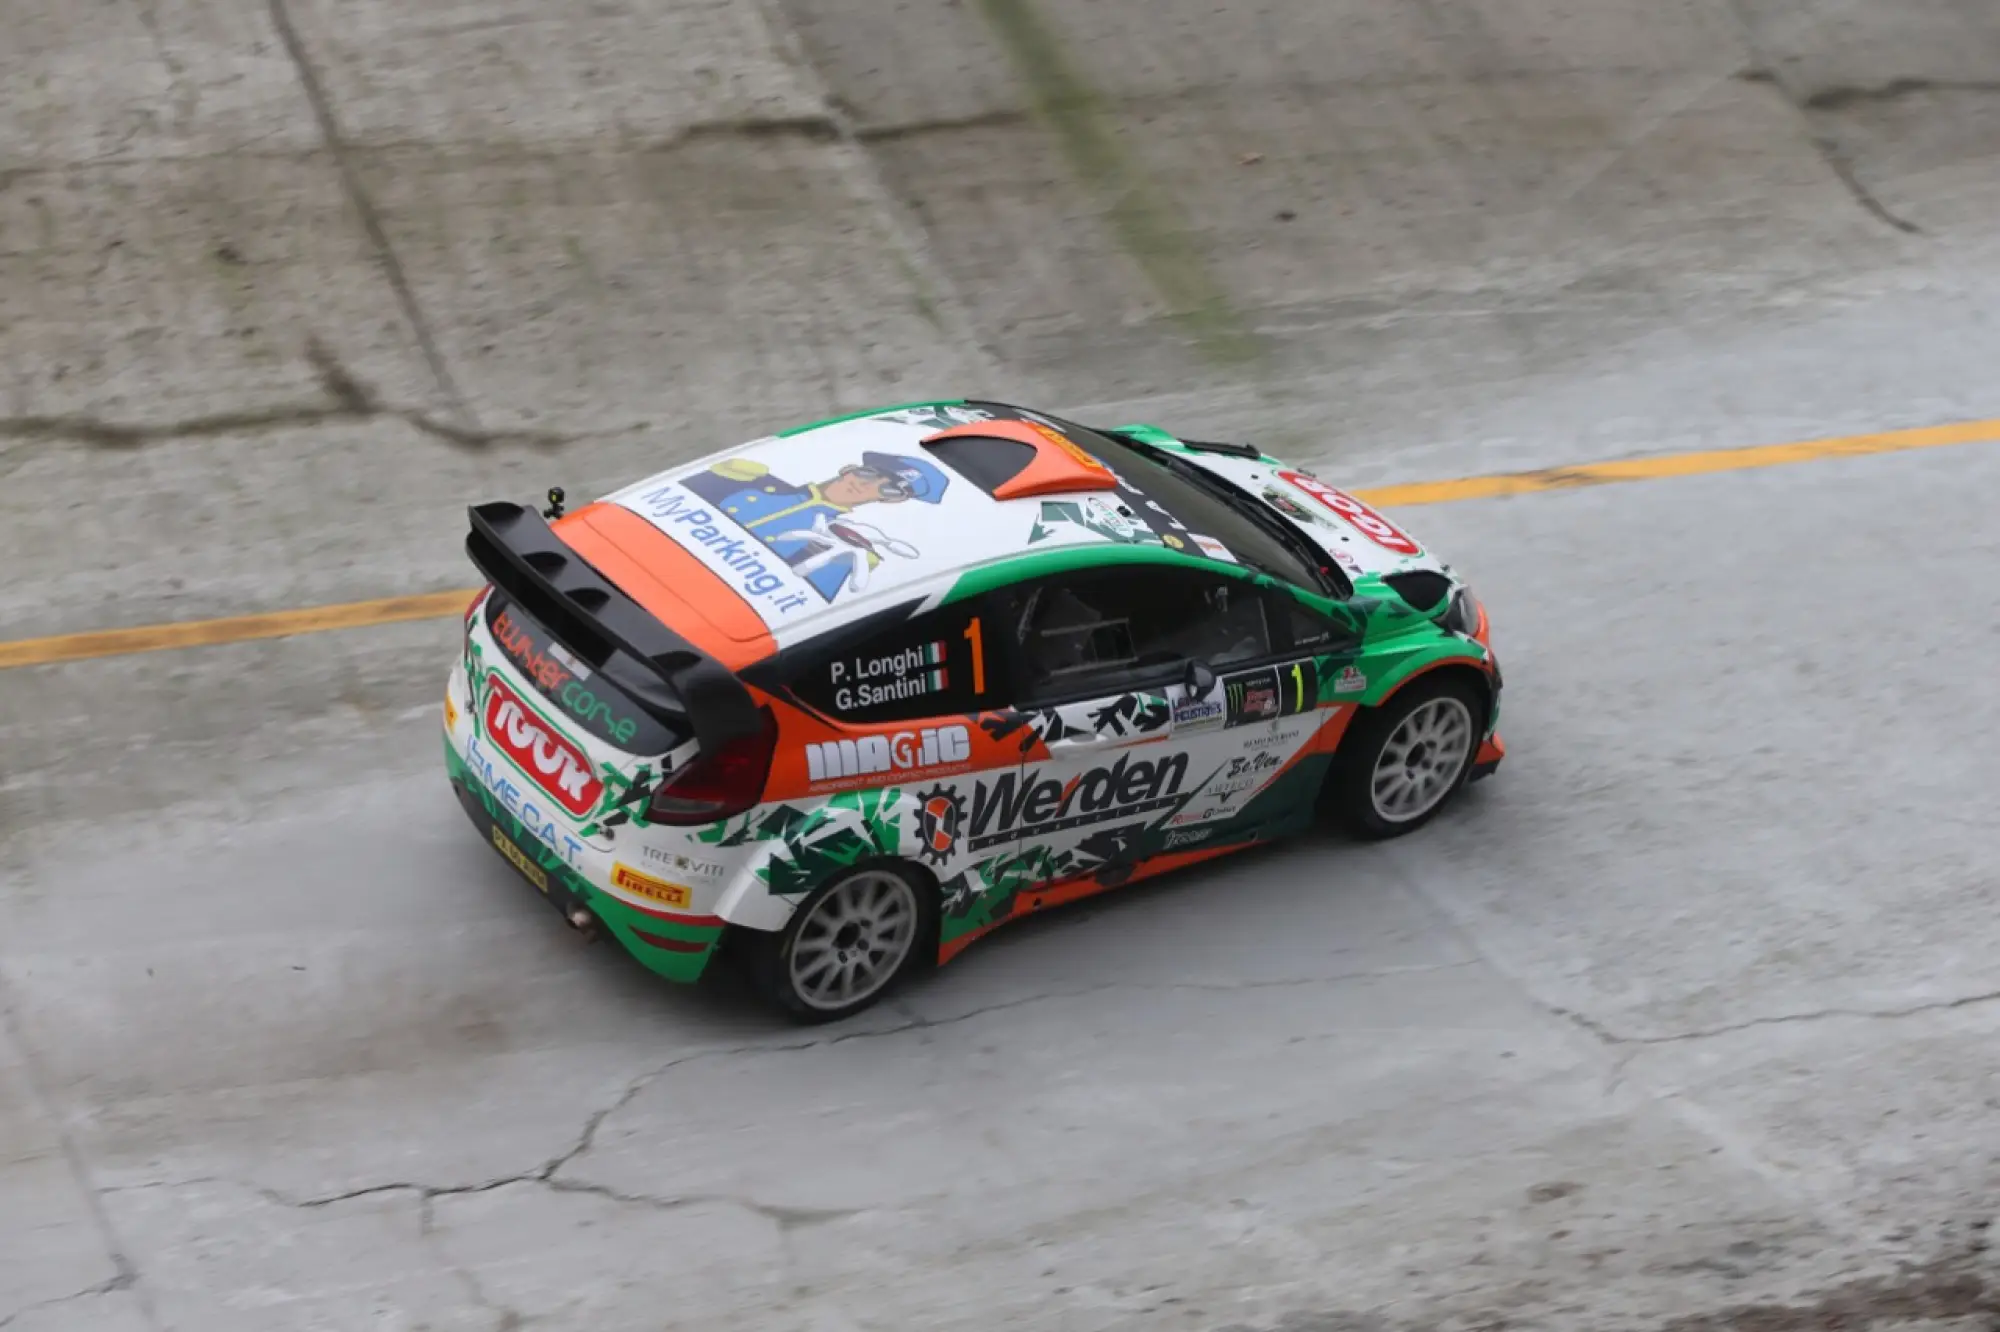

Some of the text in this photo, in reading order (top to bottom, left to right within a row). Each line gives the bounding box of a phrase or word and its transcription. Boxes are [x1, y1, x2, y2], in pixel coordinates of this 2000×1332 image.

[641, 487, 809, 613] MyParking.it
[830, 645, 924, 685] P. Longhi
[964, 617, 985, 695] 1
[836, 673, 926, 710] G.Santini
[1291, 663, 1304, 713] 1
[968, 751, 1189, 838] Werden
[617, 869, 684, 905] PIRELLI
